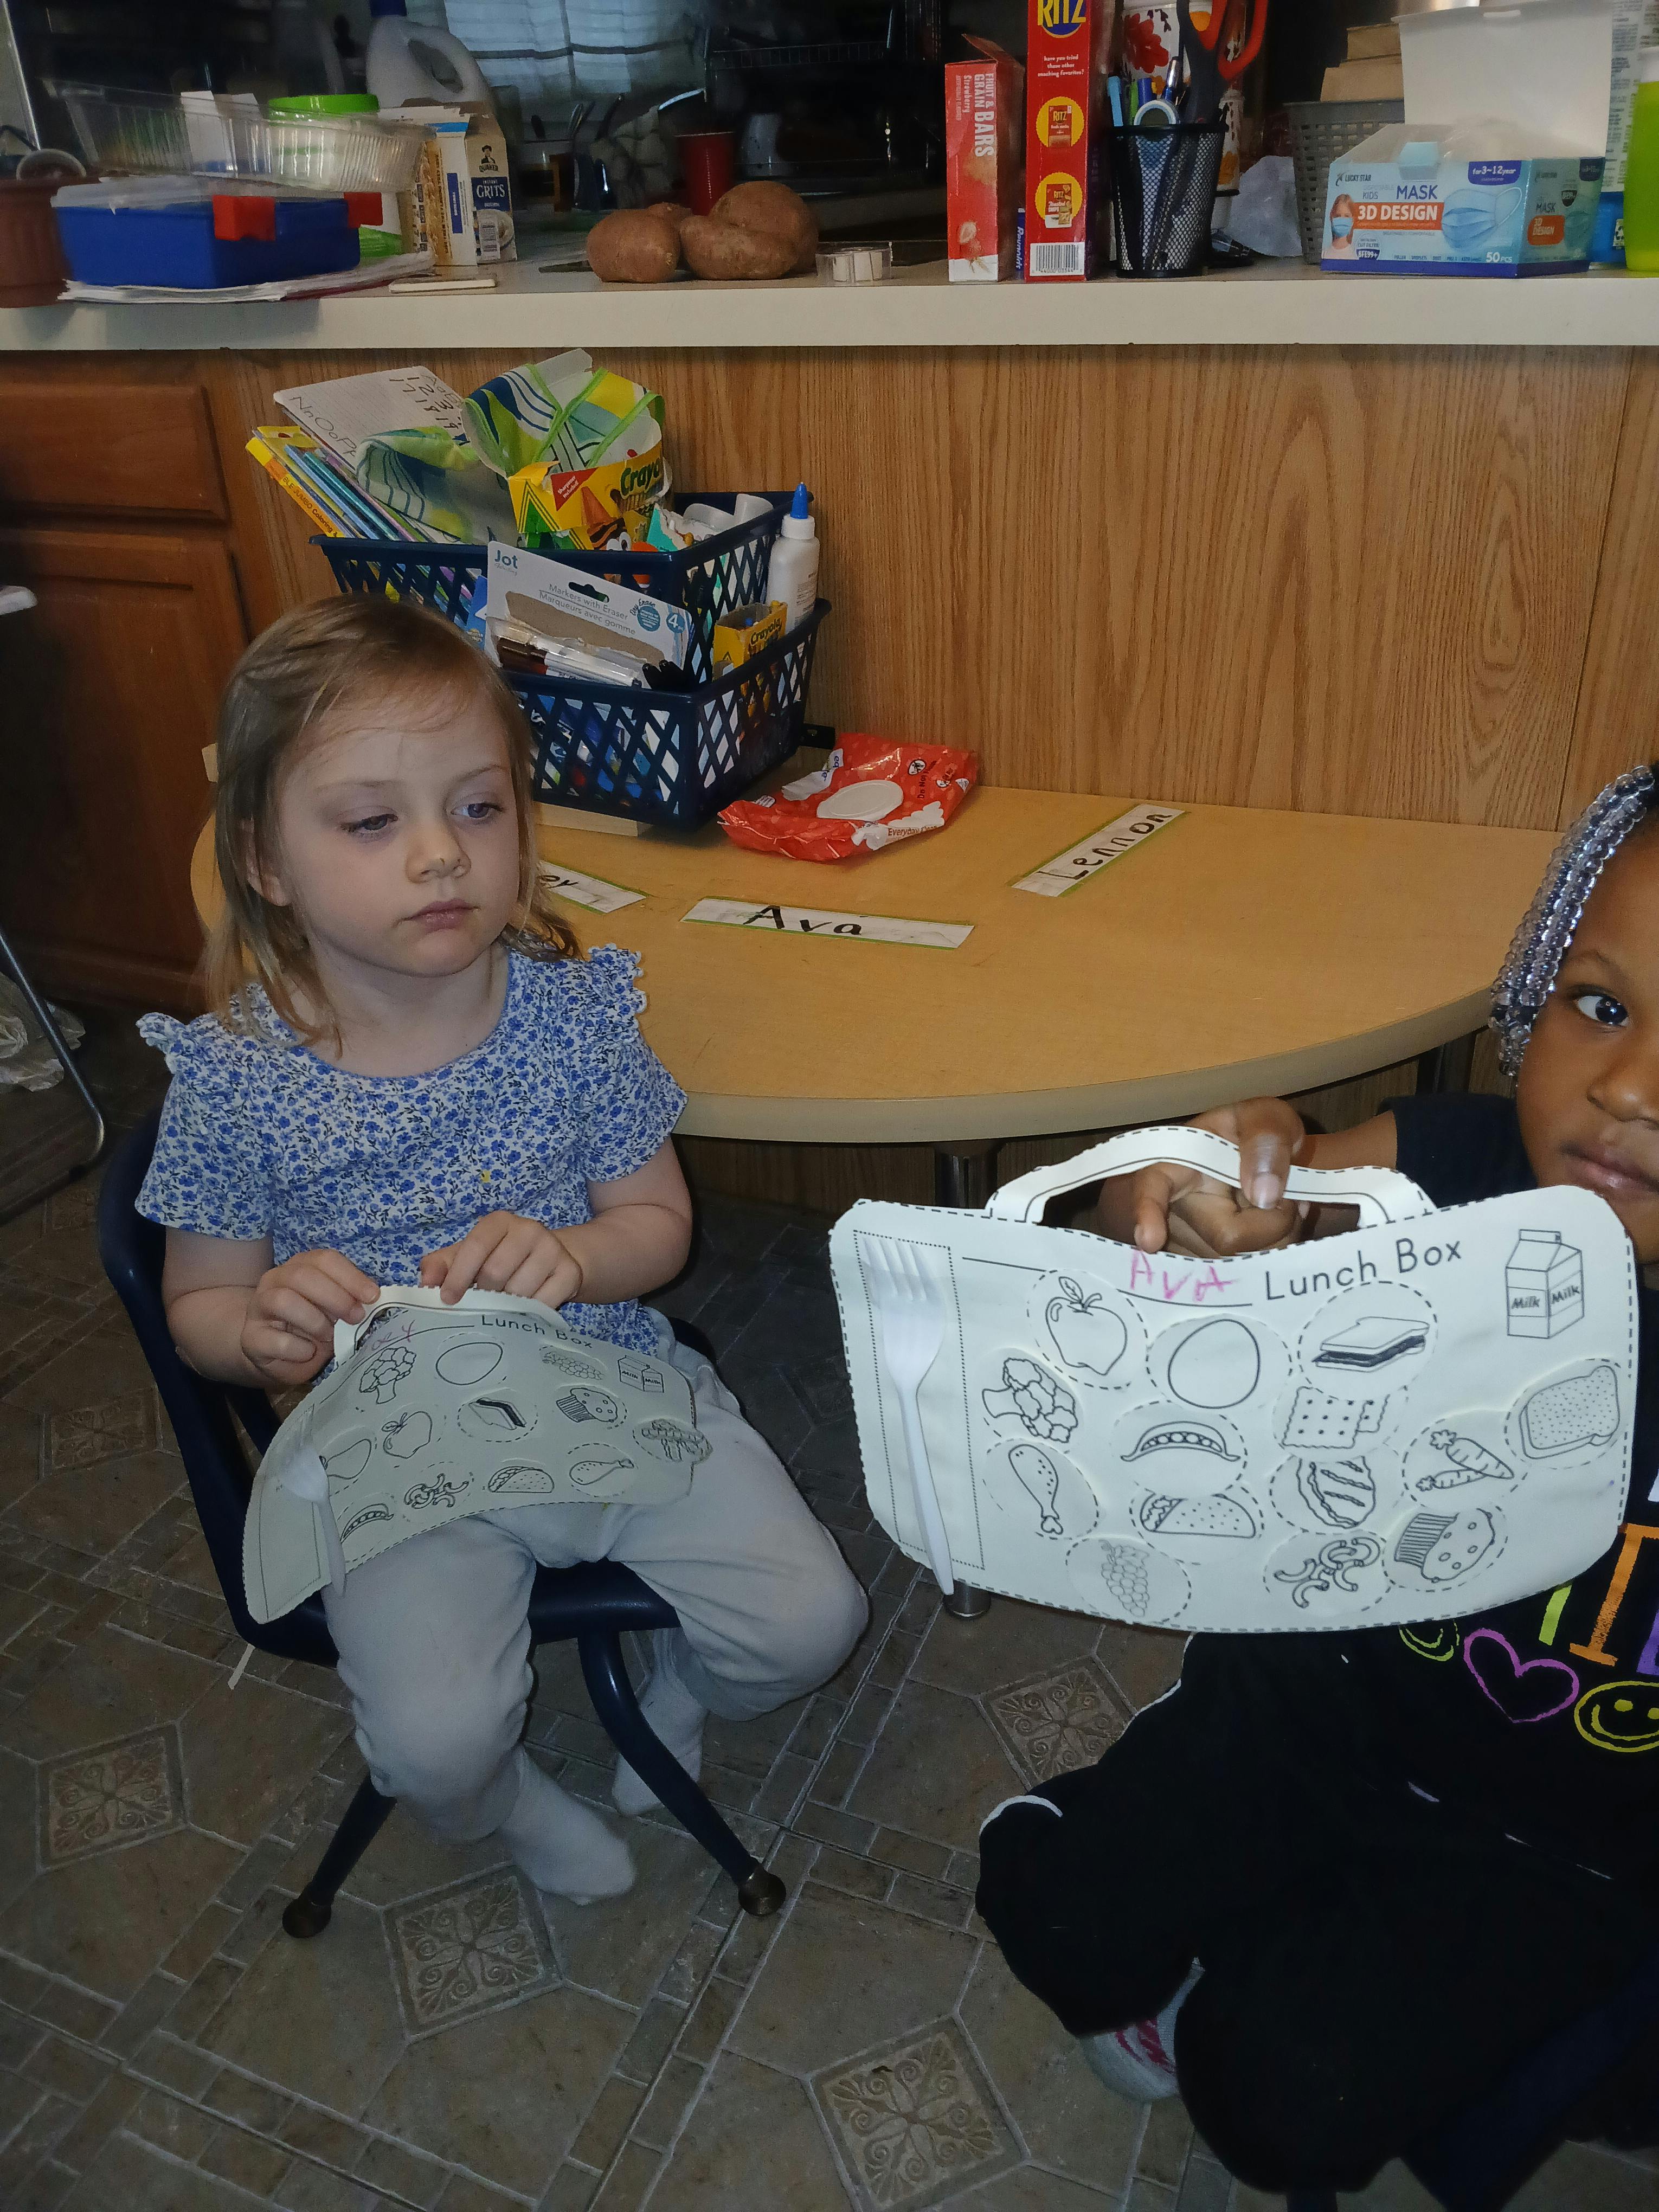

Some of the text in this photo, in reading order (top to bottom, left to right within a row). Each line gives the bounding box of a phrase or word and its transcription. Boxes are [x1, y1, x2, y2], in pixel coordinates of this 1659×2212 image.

[1038, 0, 1086, 27] RITZ
[962, 75, 972, 113] Strawberry
[985, 73, 994, 109] FRUIT &
[974, 73, 995, 157] GRAIN BARS
[1053, 111, 1067, 122] RITZ
[479, 164, 499, 172] QUAKER
[476, 185, 505, 199] GRITS
[1053, 190, 1065, 198] RITZ
[1362, 184, 1438, 200] KIDS MASK
[1358, 205, 1438, 221] 3D DESIGN
[1535, 203, 1557, 213] MASK
[1486, 251, 1501, 263] 50
[620, 458, 660, 497] Crayo
[293, 487, 313, 510] JUMBO
[312, 509, 333, 534] Coloring
[494, 549, 518, 569] Jot
[538, 590, 636, 635] Marqueurs avec gomme
[549, 584, 582, 602] Markers
[583, 598, 600, 609] with
[602, 605, 629, 621] Eraser
[668, 613, 679, 628] 4
[750, 618, 782, 645] Crayola
[916, 789, 925, 798] Do
[888, 826, 918, 837] Everyday
[1036, 813, 1173, 880] Lennon
[743, 905, 862, 935] Ava
[1130, 1249, 1238, 1302] AVA
[1263, 1238, 1462, 1301] Lunch Box
[1512, 1296, 1541, 1310] Milk
[1551, 1285, 1580, 1304] Milk
[481, 1315, 593, 1348] Lunch Box
